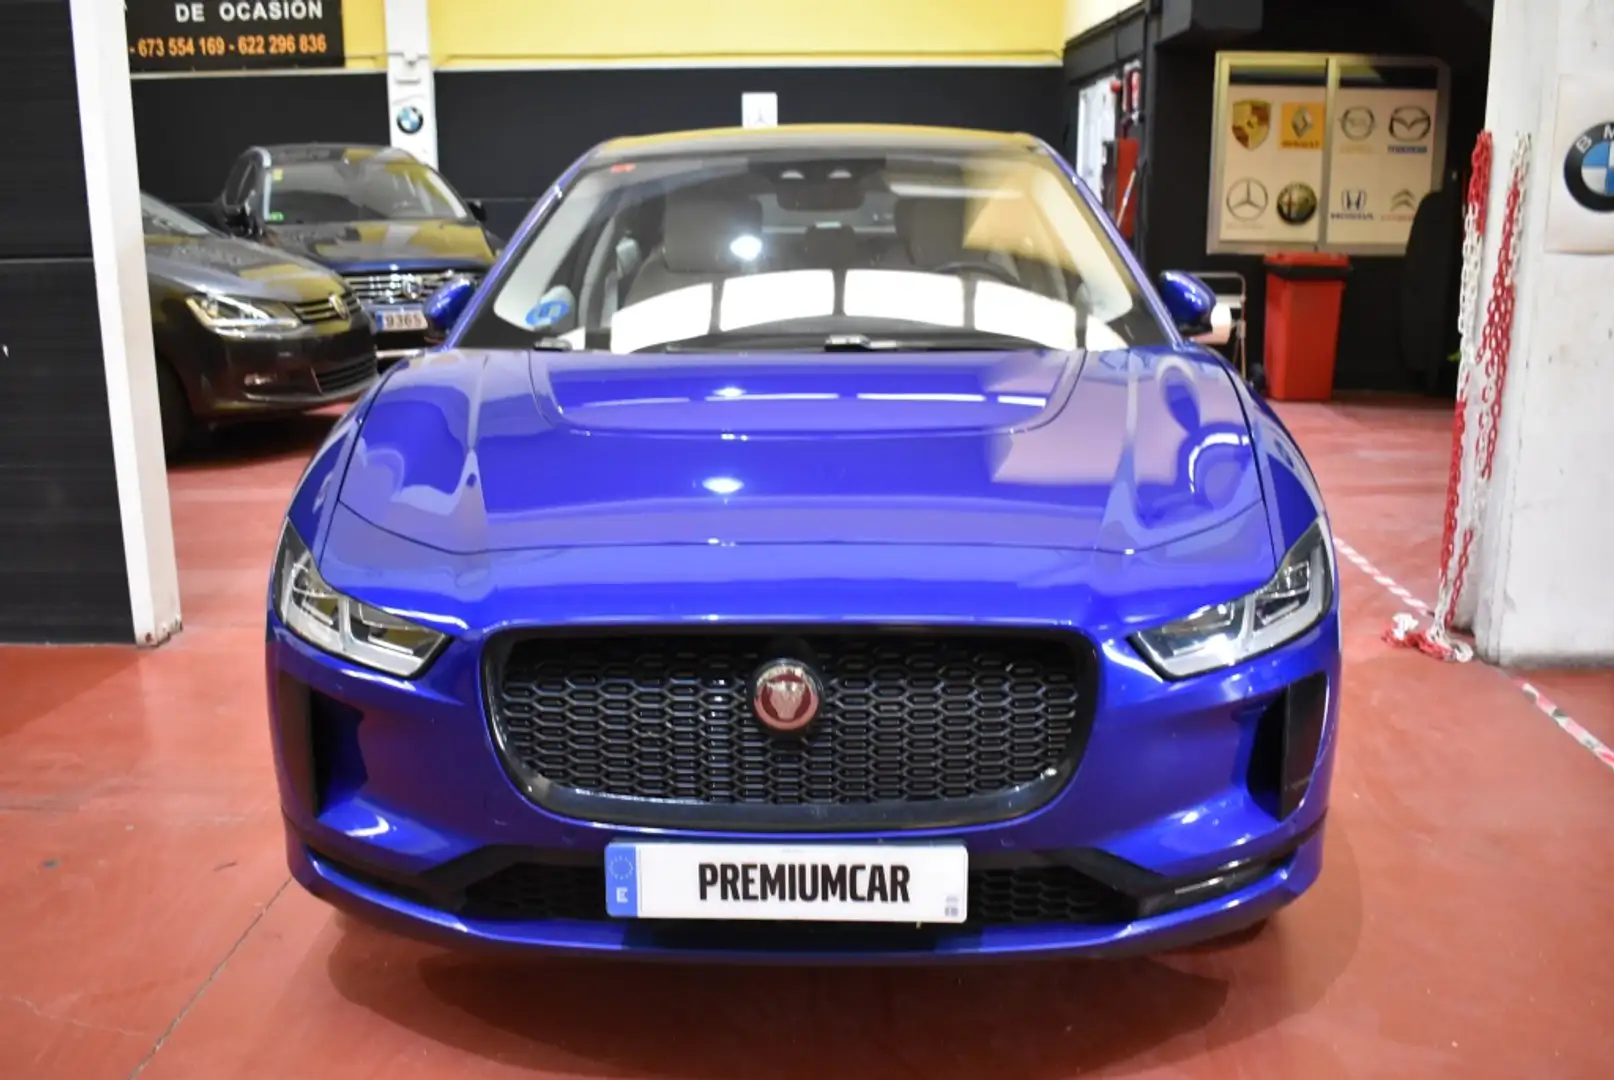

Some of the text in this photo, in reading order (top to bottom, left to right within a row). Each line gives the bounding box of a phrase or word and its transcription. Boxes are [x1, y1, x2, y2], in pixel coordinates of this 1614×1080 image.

[175, 3, 205, 23] DE
[138, 38, 165, 58] 673
[168, 37, 195, 57] 554
[199, 36, 225, 55] 169
[238, 34, 265, 55] 622
[269, 33, 296, 53] 296
[300, 32, 327, 52] 836
[698, 862, 911, 904] PREMIUMCAR
[616, 886, 629, 904] E
